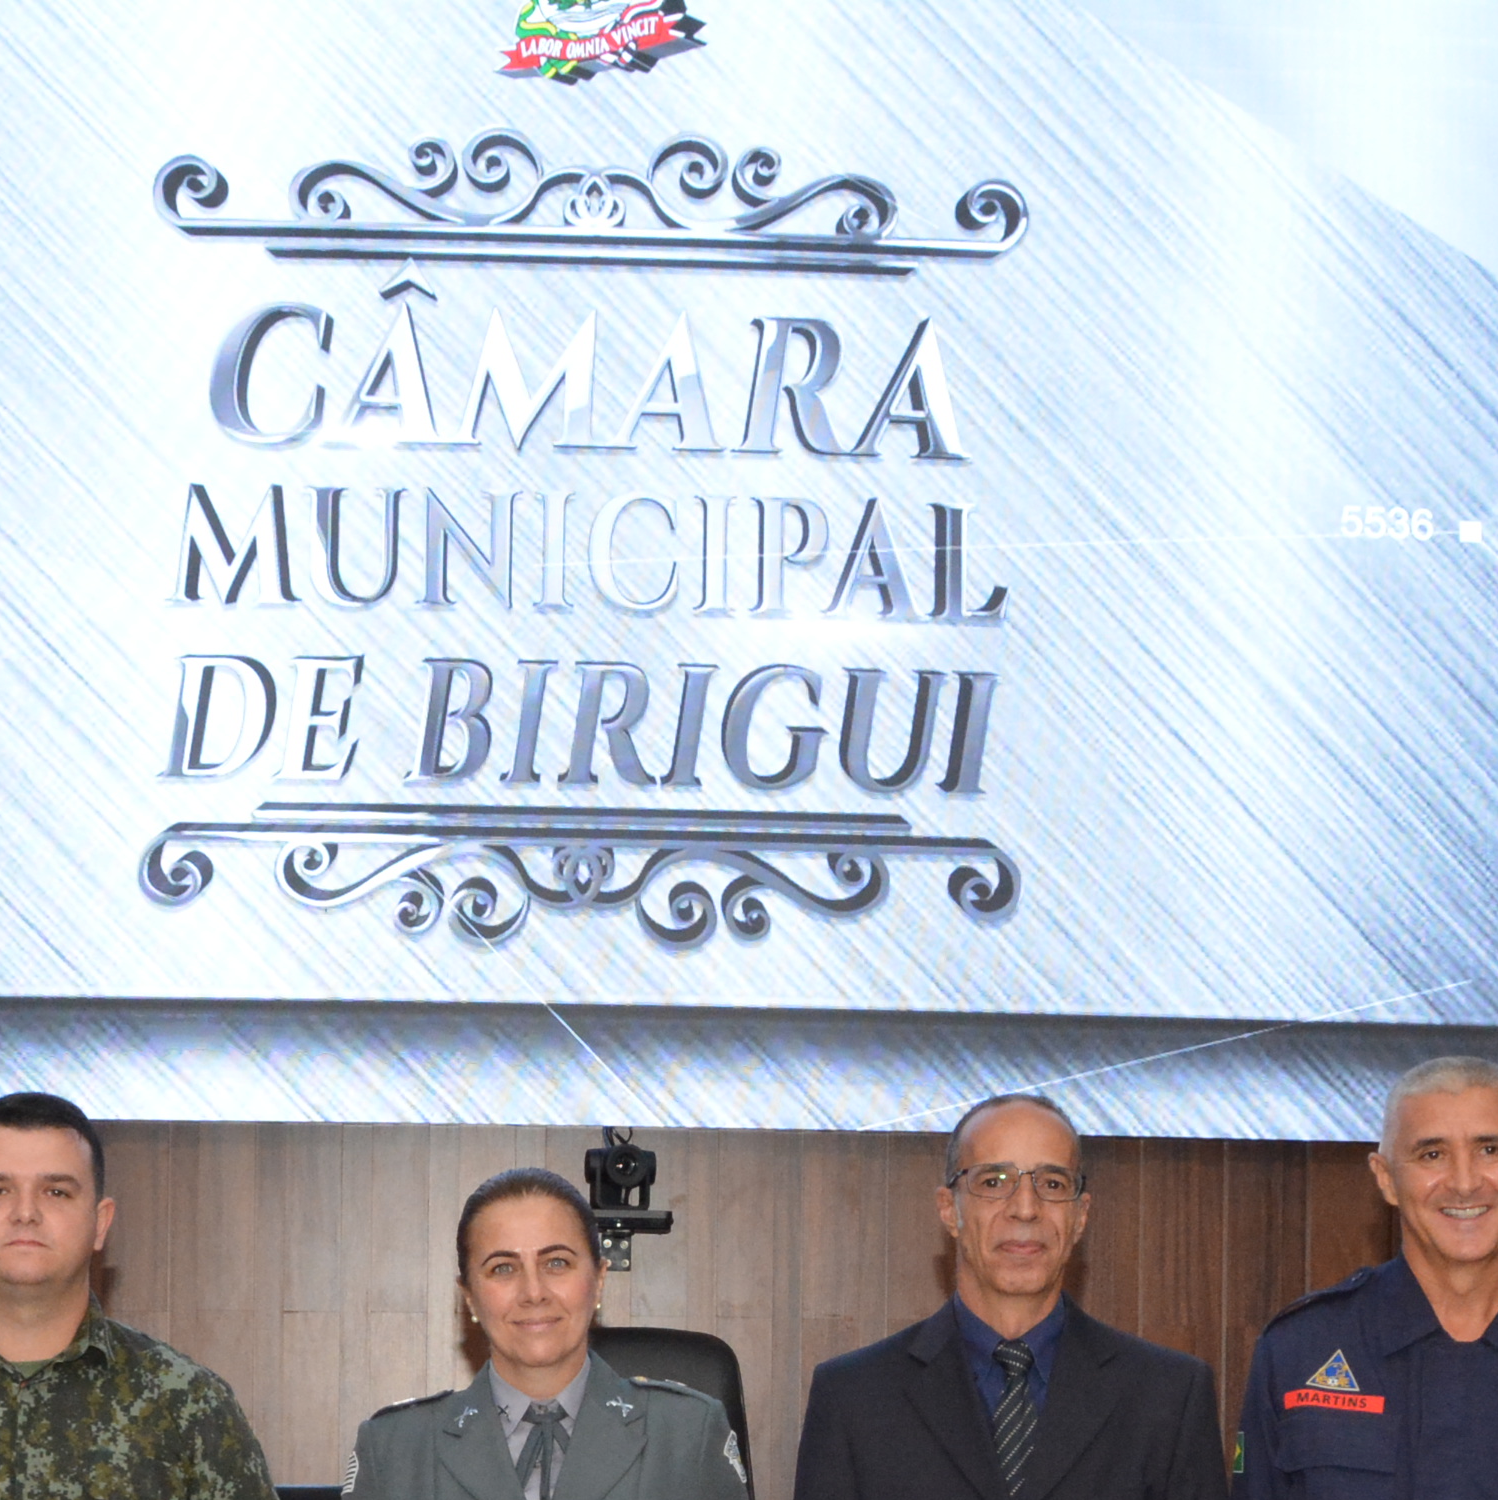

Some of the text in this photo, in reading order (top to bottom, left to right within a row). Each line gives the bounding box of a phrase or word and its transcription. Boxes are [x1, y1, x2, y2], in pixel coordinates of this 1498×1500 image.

[520, 16, 659, 59] LABOR OMNIA VINCIT
[209, 258, 971, 461] CÂMARA
[167, 483, 1010, 622] MUNICIPAL
[1340, 505, 1434, 541] 5536
[157, 653, 997, 795] DE BIRIGUI
[1296, 1392, 1367, 1408] MARTINS
